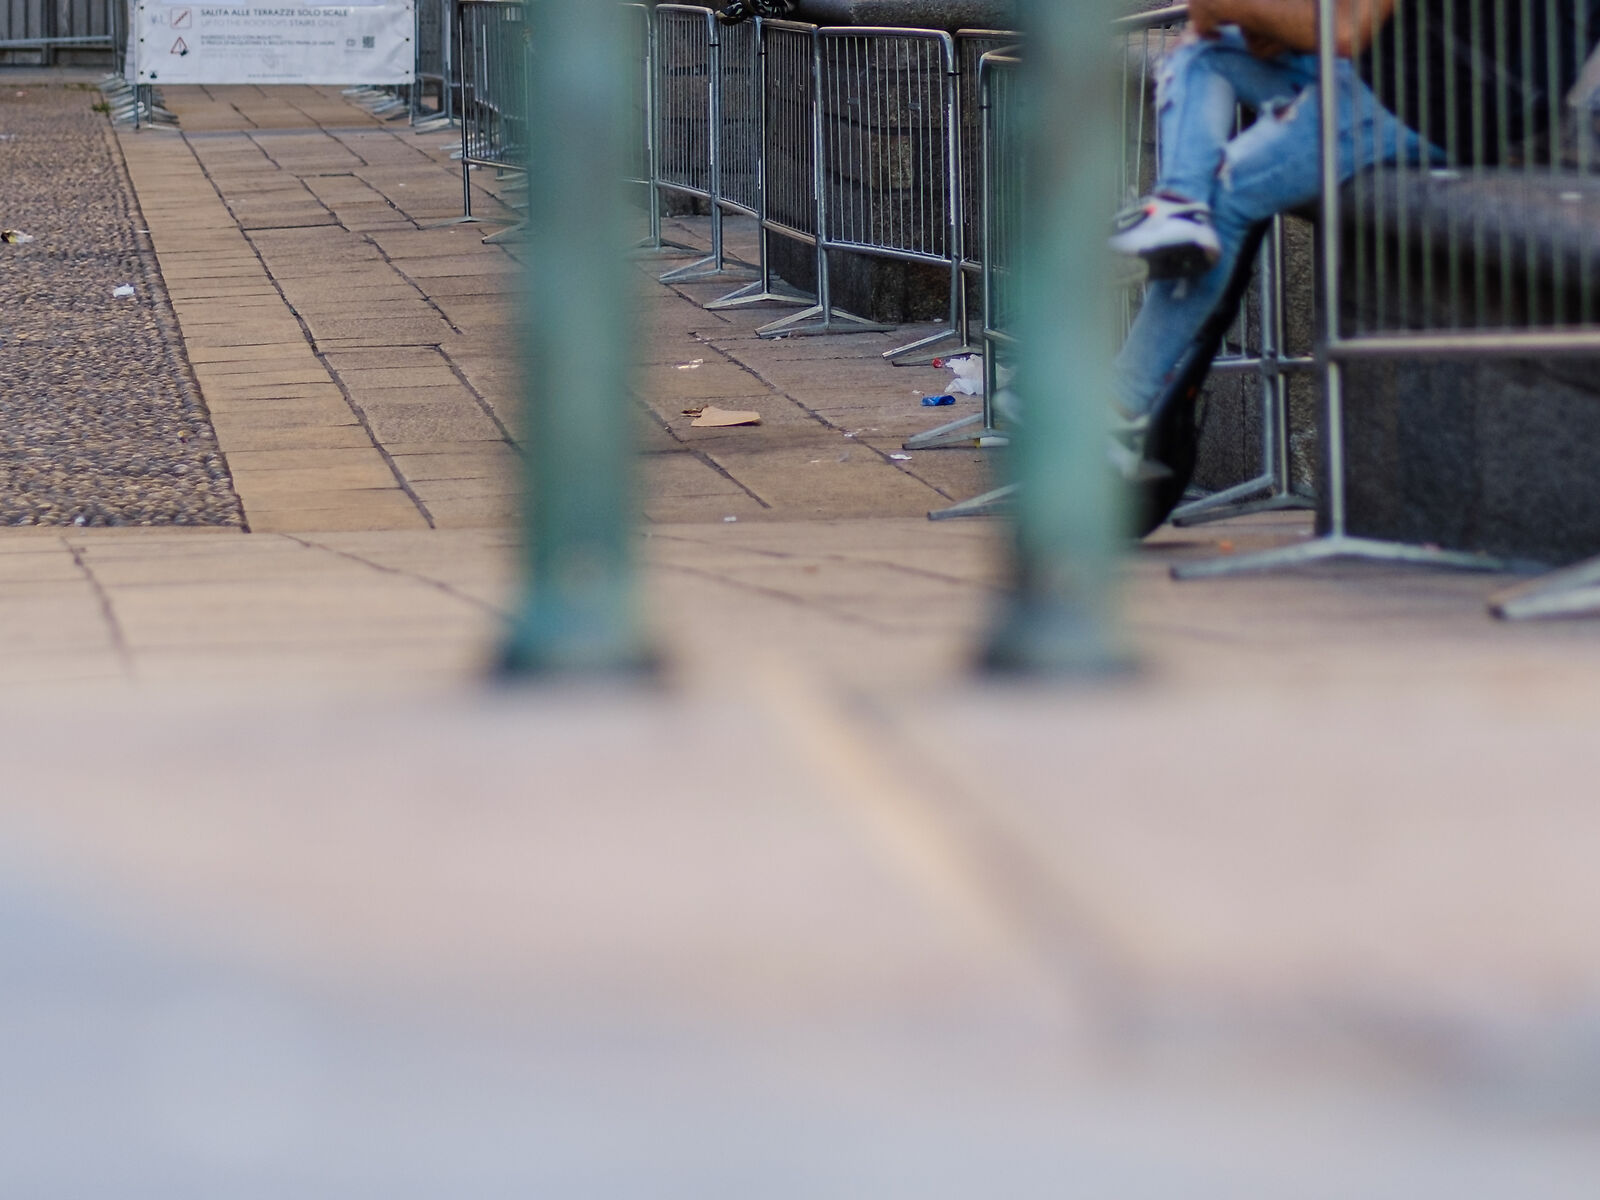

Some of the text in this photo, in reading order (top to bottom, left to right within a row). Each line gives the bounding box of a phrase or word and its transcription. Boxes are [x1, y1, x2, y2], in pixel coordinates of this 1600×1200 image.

[201, 8, 348, 17] SALITA ALLE TERRAZZE SOLO SCALE
